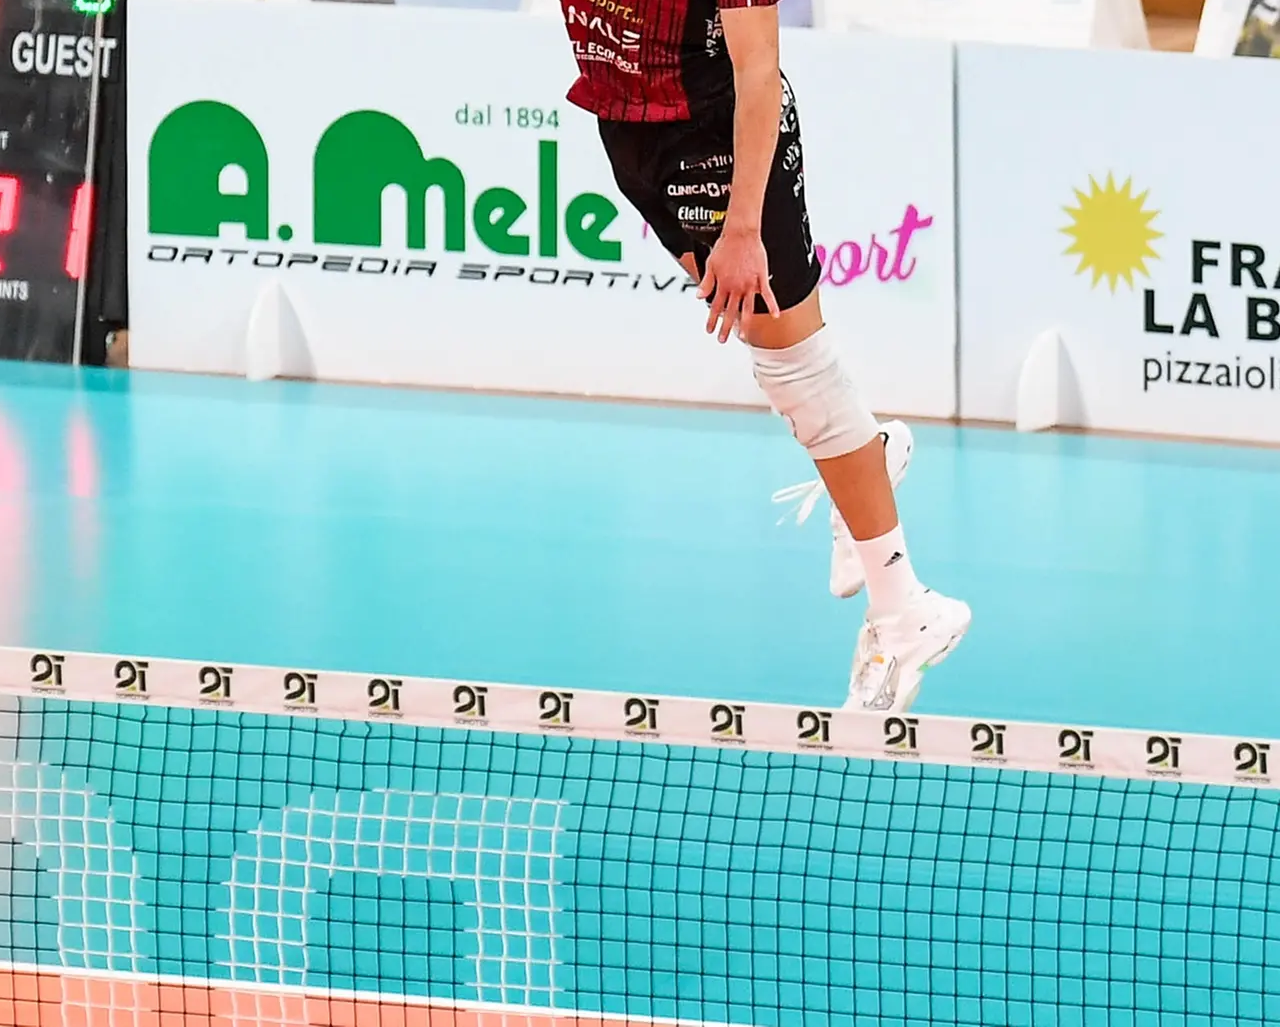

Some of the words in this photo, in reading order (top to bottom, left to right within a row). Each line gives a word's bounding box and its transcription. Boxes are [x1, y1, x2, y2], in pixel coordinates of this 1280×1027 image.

[11, 31, 117, 77] GUEST
[455, 103, 492, 127] dal
[501, 105, 560, 130] 1894
[1143, 289, 1219, 338] LA
